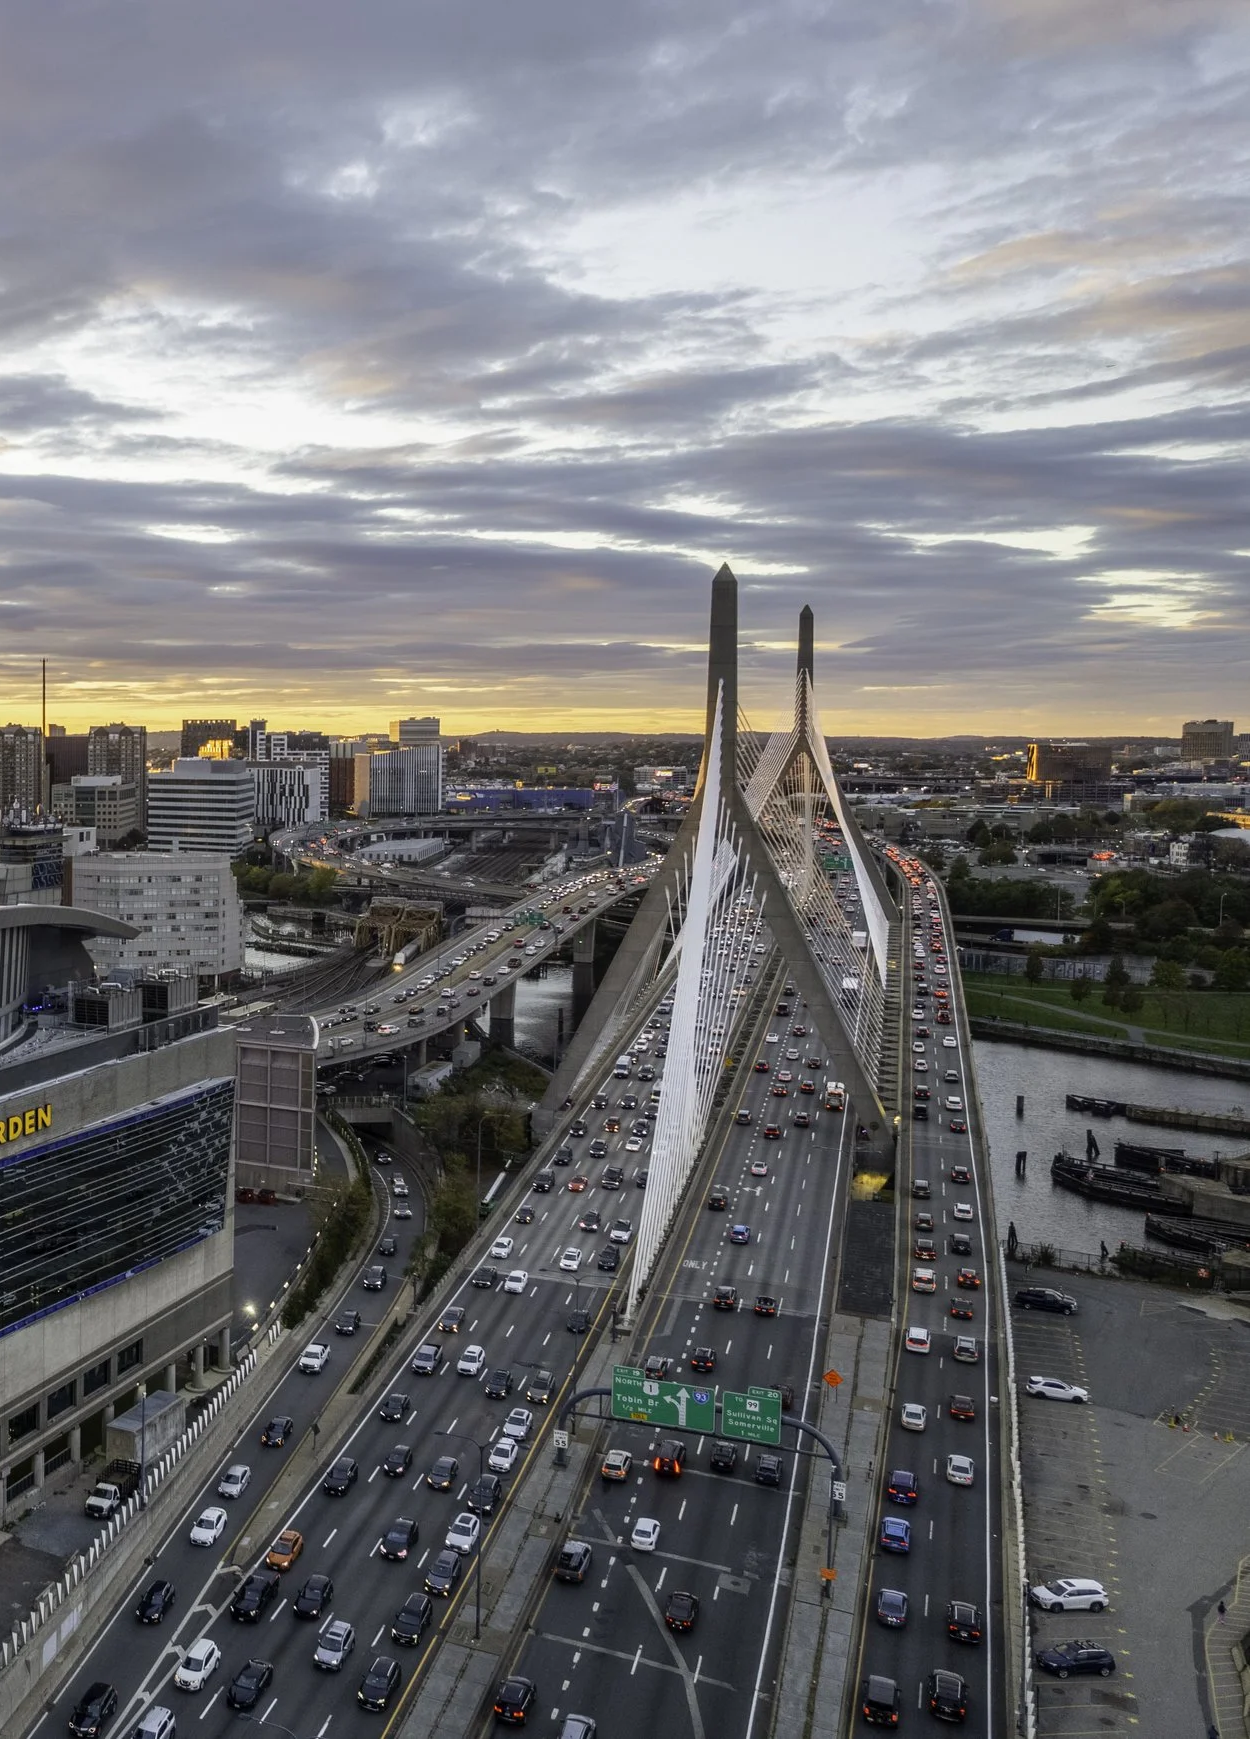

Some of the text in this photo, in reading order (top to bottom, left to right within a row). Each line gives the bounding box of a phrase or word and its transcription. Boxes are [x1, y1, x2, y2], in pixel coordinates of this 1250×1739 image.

[682, 1259, 708, 1270] ONLY
[615, 1377, 642, 1387] NORTH
[615, 1393, 659, 1407] Tobin Br
[695, 1392, 707, 1402] 93
[767, 1391, 779, 1399] 20
[747, 1401, 758, 1409] 99
[726, 1409, 778, 1426] Sullivan Sq
[728, 1418, 775, 1433] Somerville
[555, 1439, 566, 1447] 55
